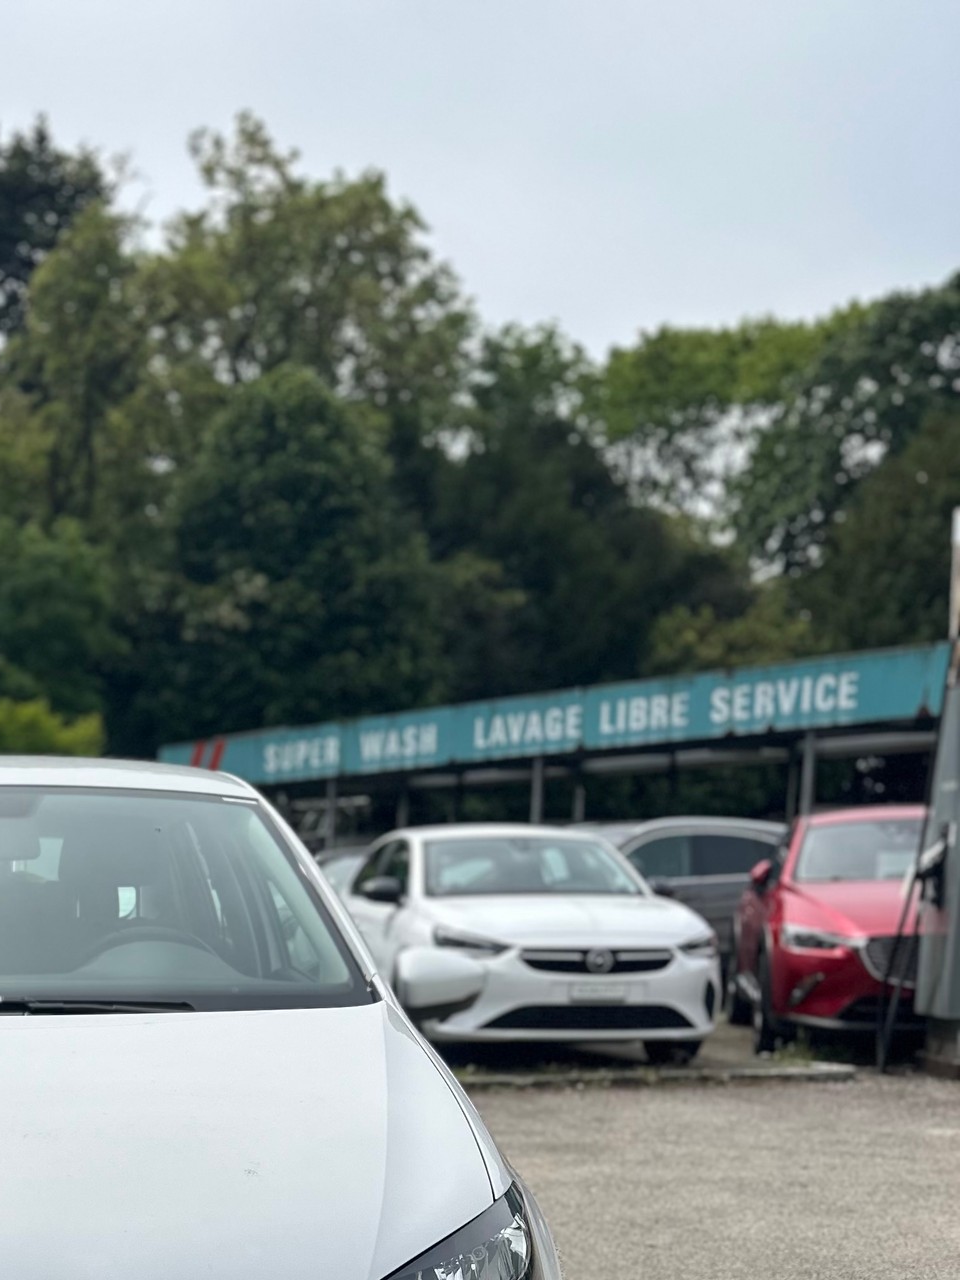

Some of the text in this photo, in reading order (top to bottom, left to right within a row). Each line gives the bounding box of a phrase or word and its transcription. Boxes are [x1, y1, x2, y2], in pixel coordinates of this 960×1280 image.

[263, 671, 860, 773] SUPER WASH LAVAGE LIBRE SERVICE
